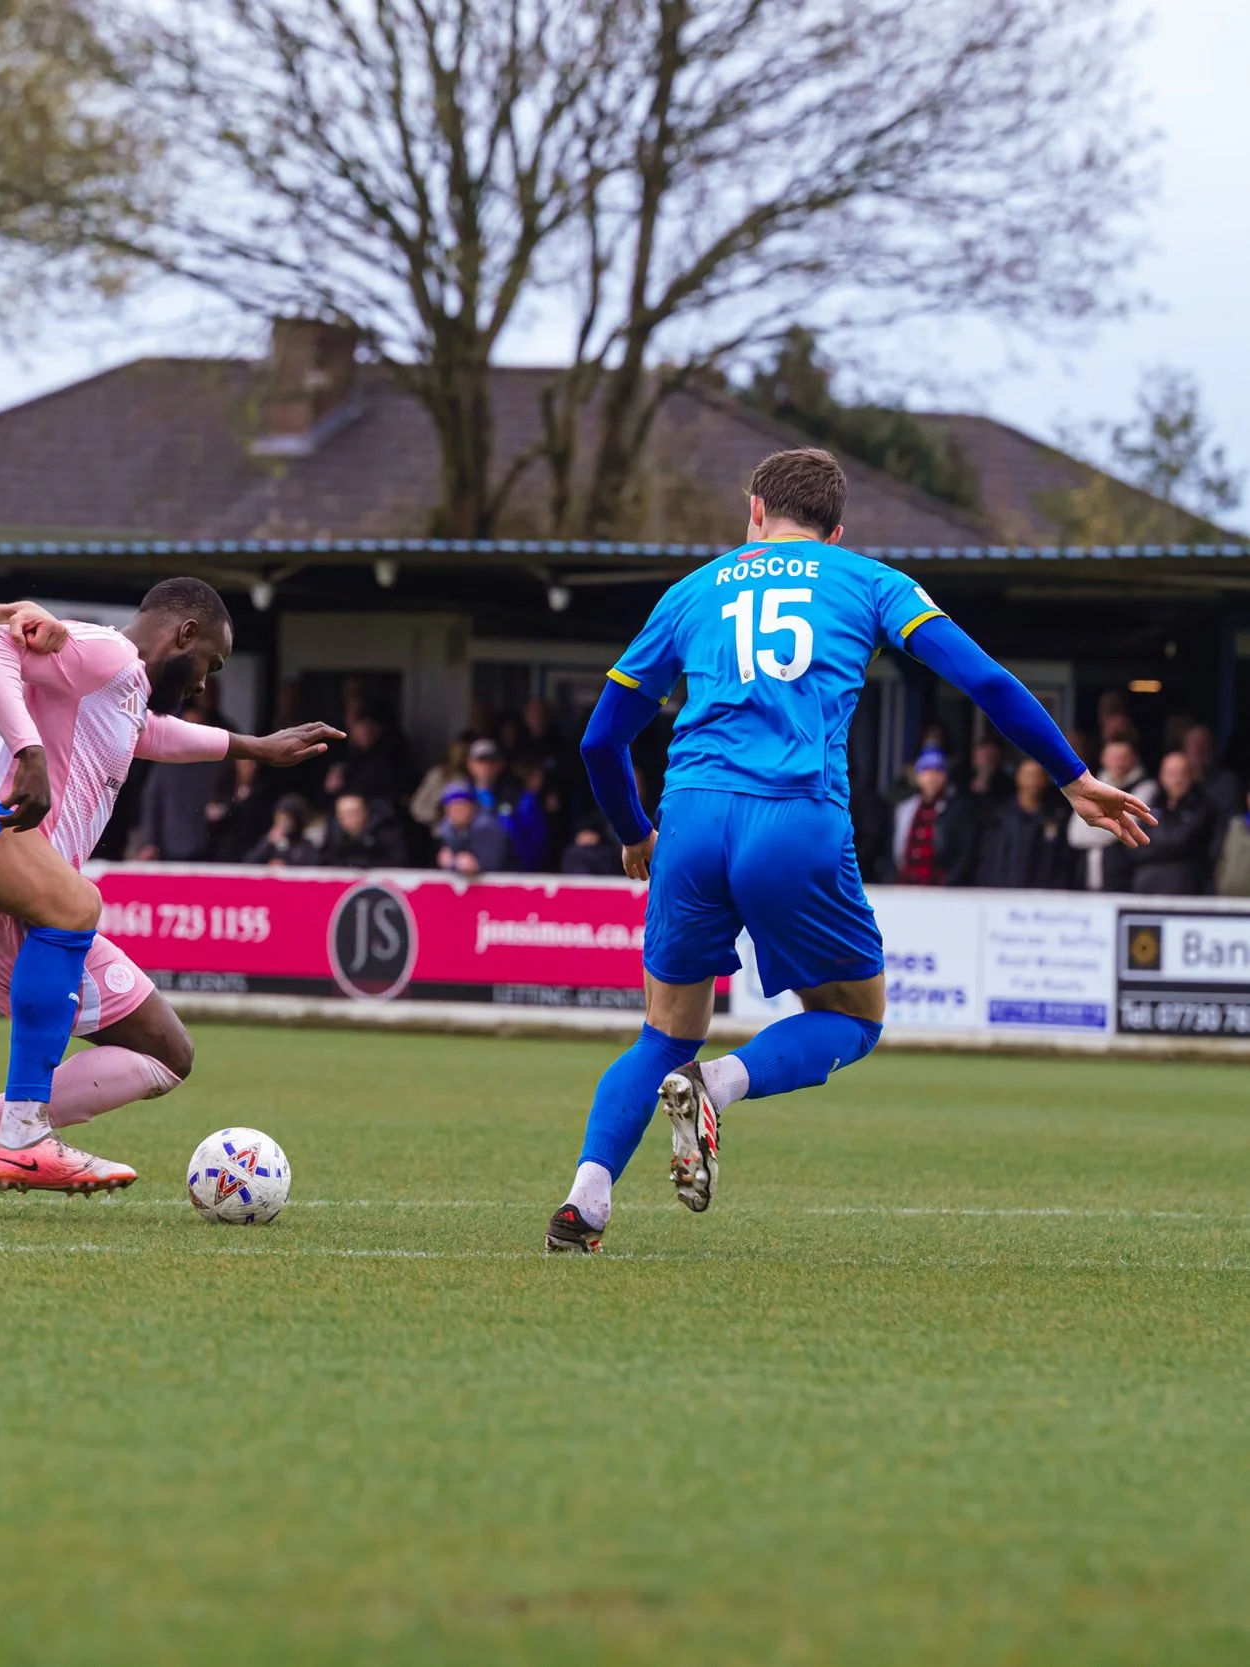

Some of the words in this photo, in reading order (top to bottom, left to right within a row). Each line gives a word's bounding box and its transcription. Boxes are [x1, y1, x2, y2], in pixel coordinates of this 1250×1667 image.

[716, 557, 820, 585] ROSCOE
[722, 588, 814, 684] 15
[156, 903, 207, 941] 723
[210, 906, 272, 944] 1155
[351, 897, 401, 972] JS
